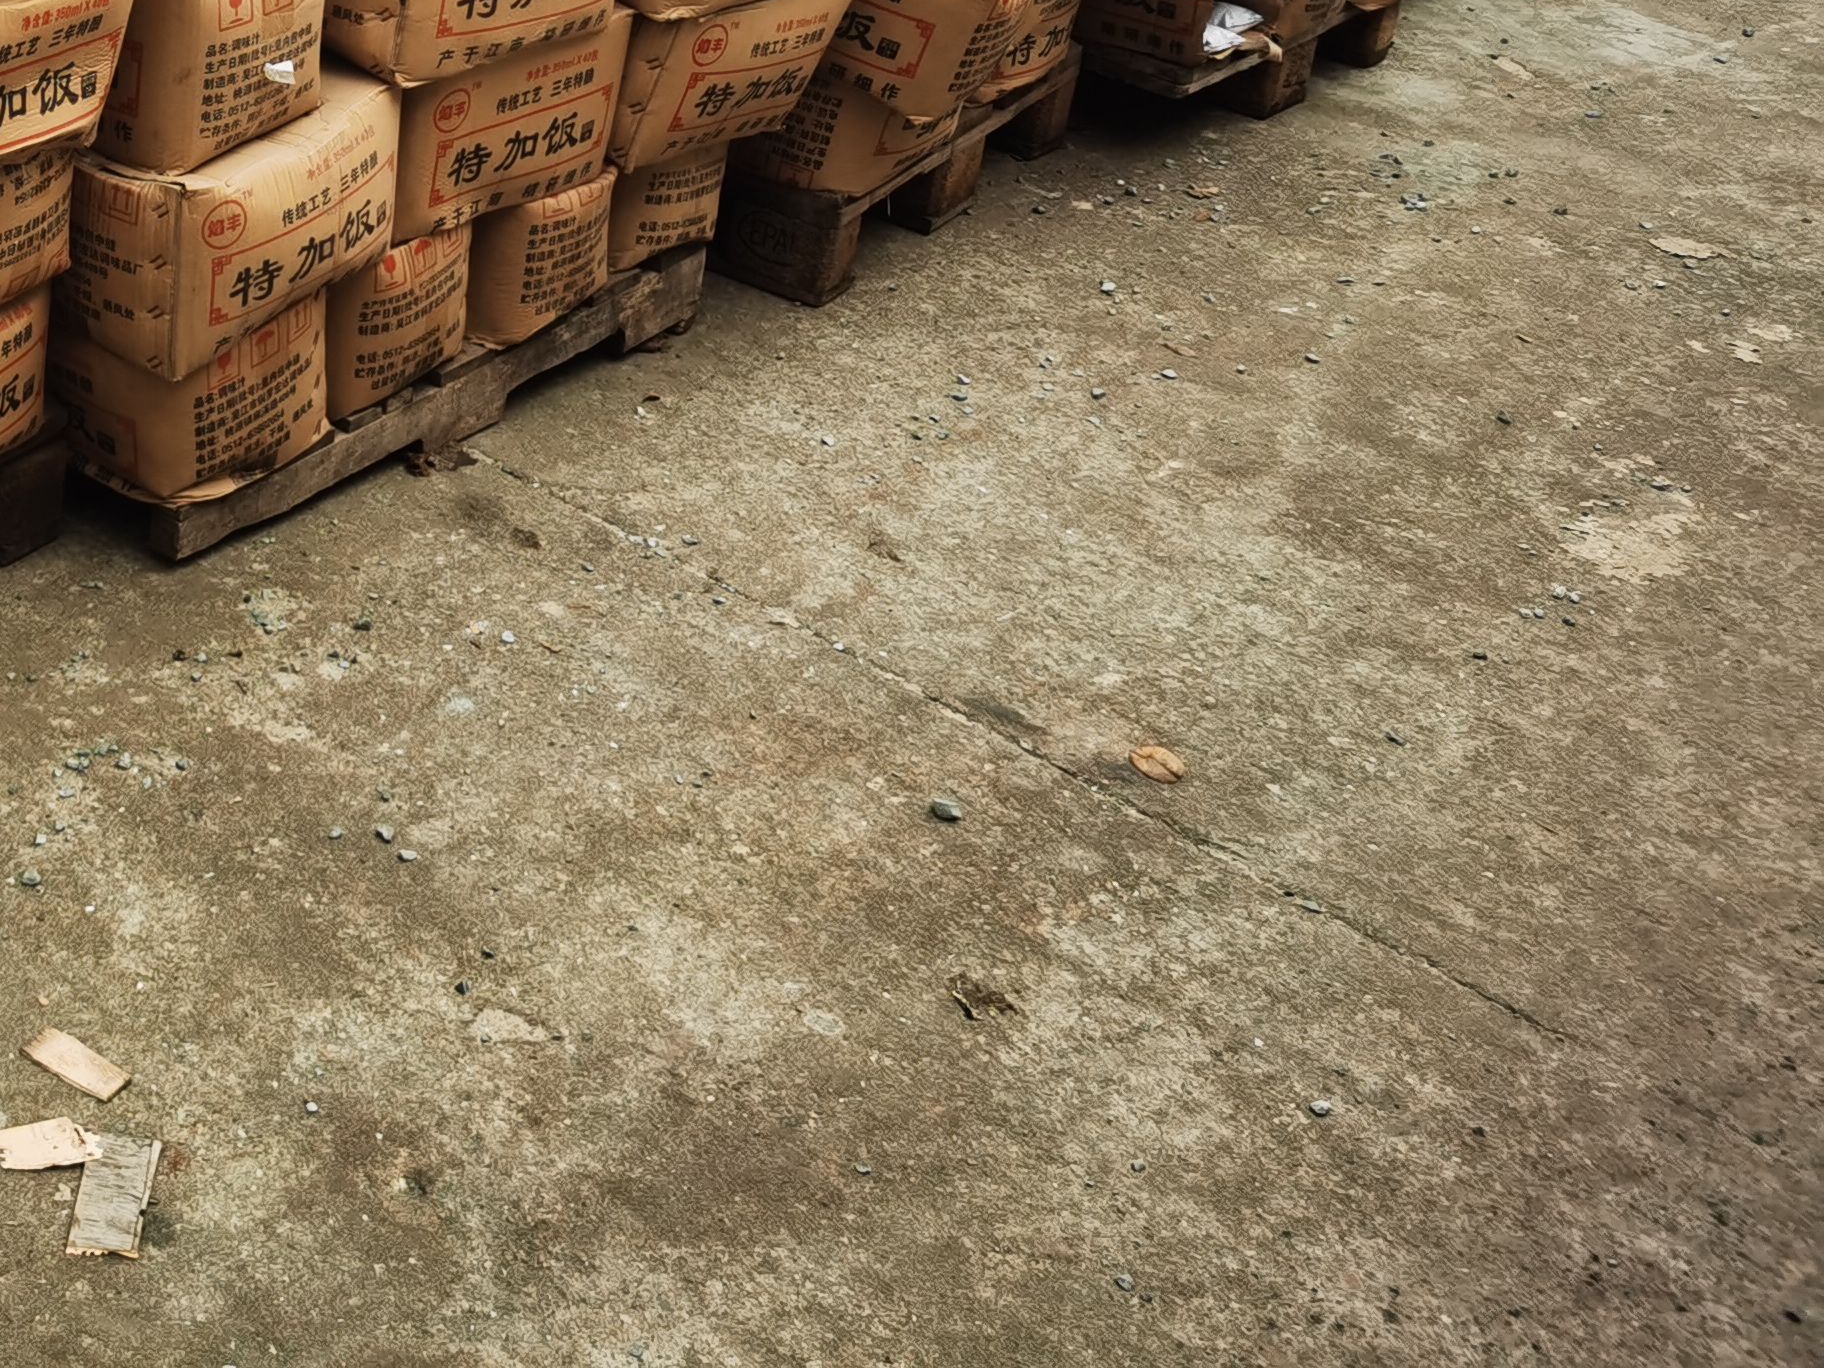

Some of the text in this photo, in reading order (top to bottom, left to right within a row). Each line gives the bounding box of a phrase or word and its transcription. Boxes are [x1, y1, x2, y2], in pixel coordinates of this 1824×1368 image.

[48, 18, 103, 49] 三年特酿
[496, 69, 595, 115] 传统工艺 三年特酿
[695, 66, 803, 118] 特加饭
[447, 112, 579, 188] 特加饭
[282, 152, 378, 227] 传统工艺 三年特酿
[229, 199, 375, 307] 特加饭
